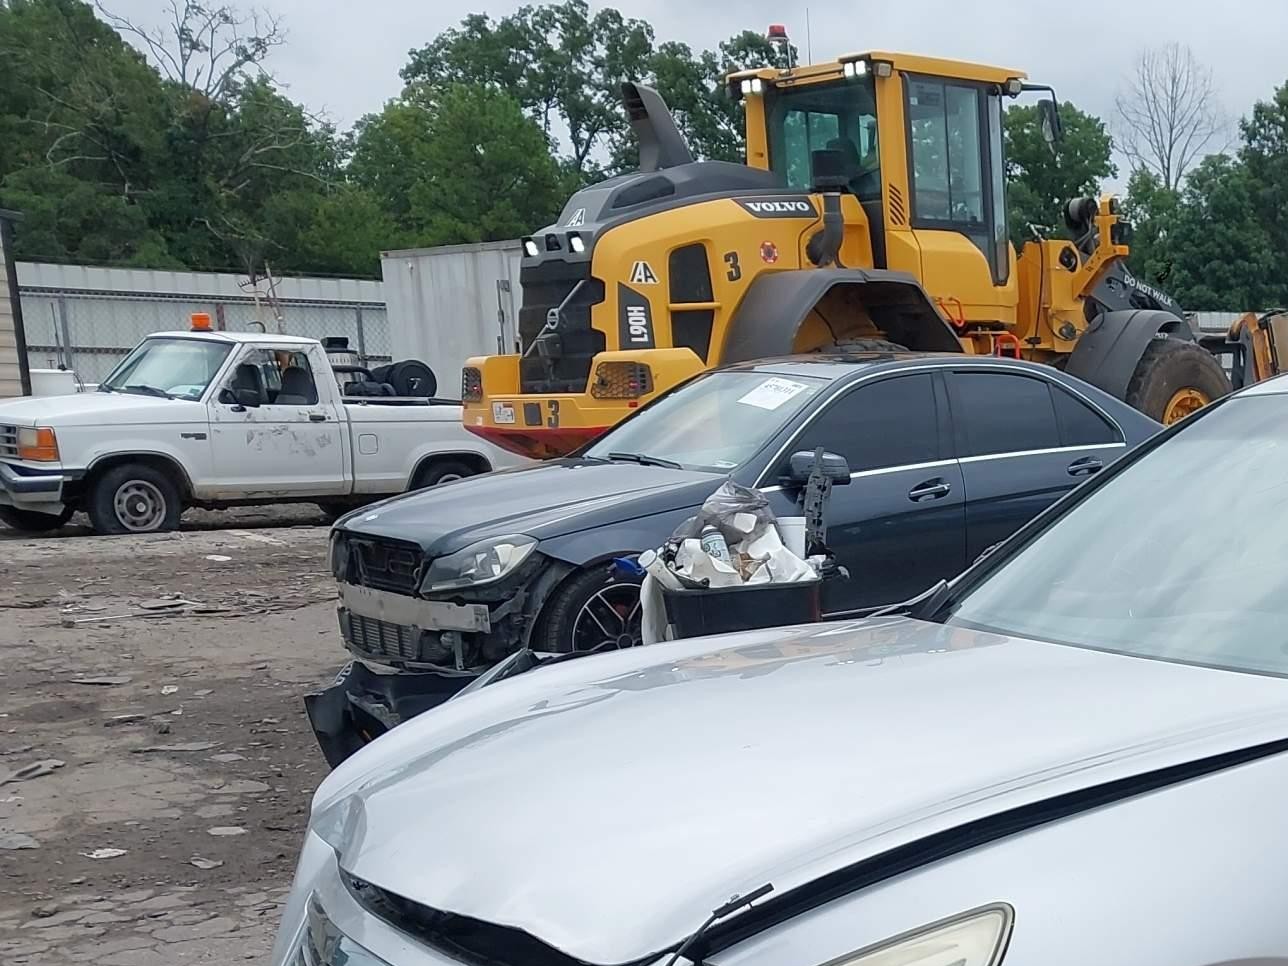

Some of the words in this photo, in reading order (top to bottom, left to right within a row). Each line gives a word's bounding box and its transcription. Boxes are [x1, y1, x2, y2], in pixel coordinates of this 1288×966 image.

[745, 201, 810, 212] VOLVO
[724, 251, 742, 282] 3
[1124, 274, 1136, 286] DO
[1136, 280, 1151, 295] NOT
[1152, 289, 1172, 307] WALK
[626, 306, 649, 342] L90H
[547, 400, 560, 427] 3
